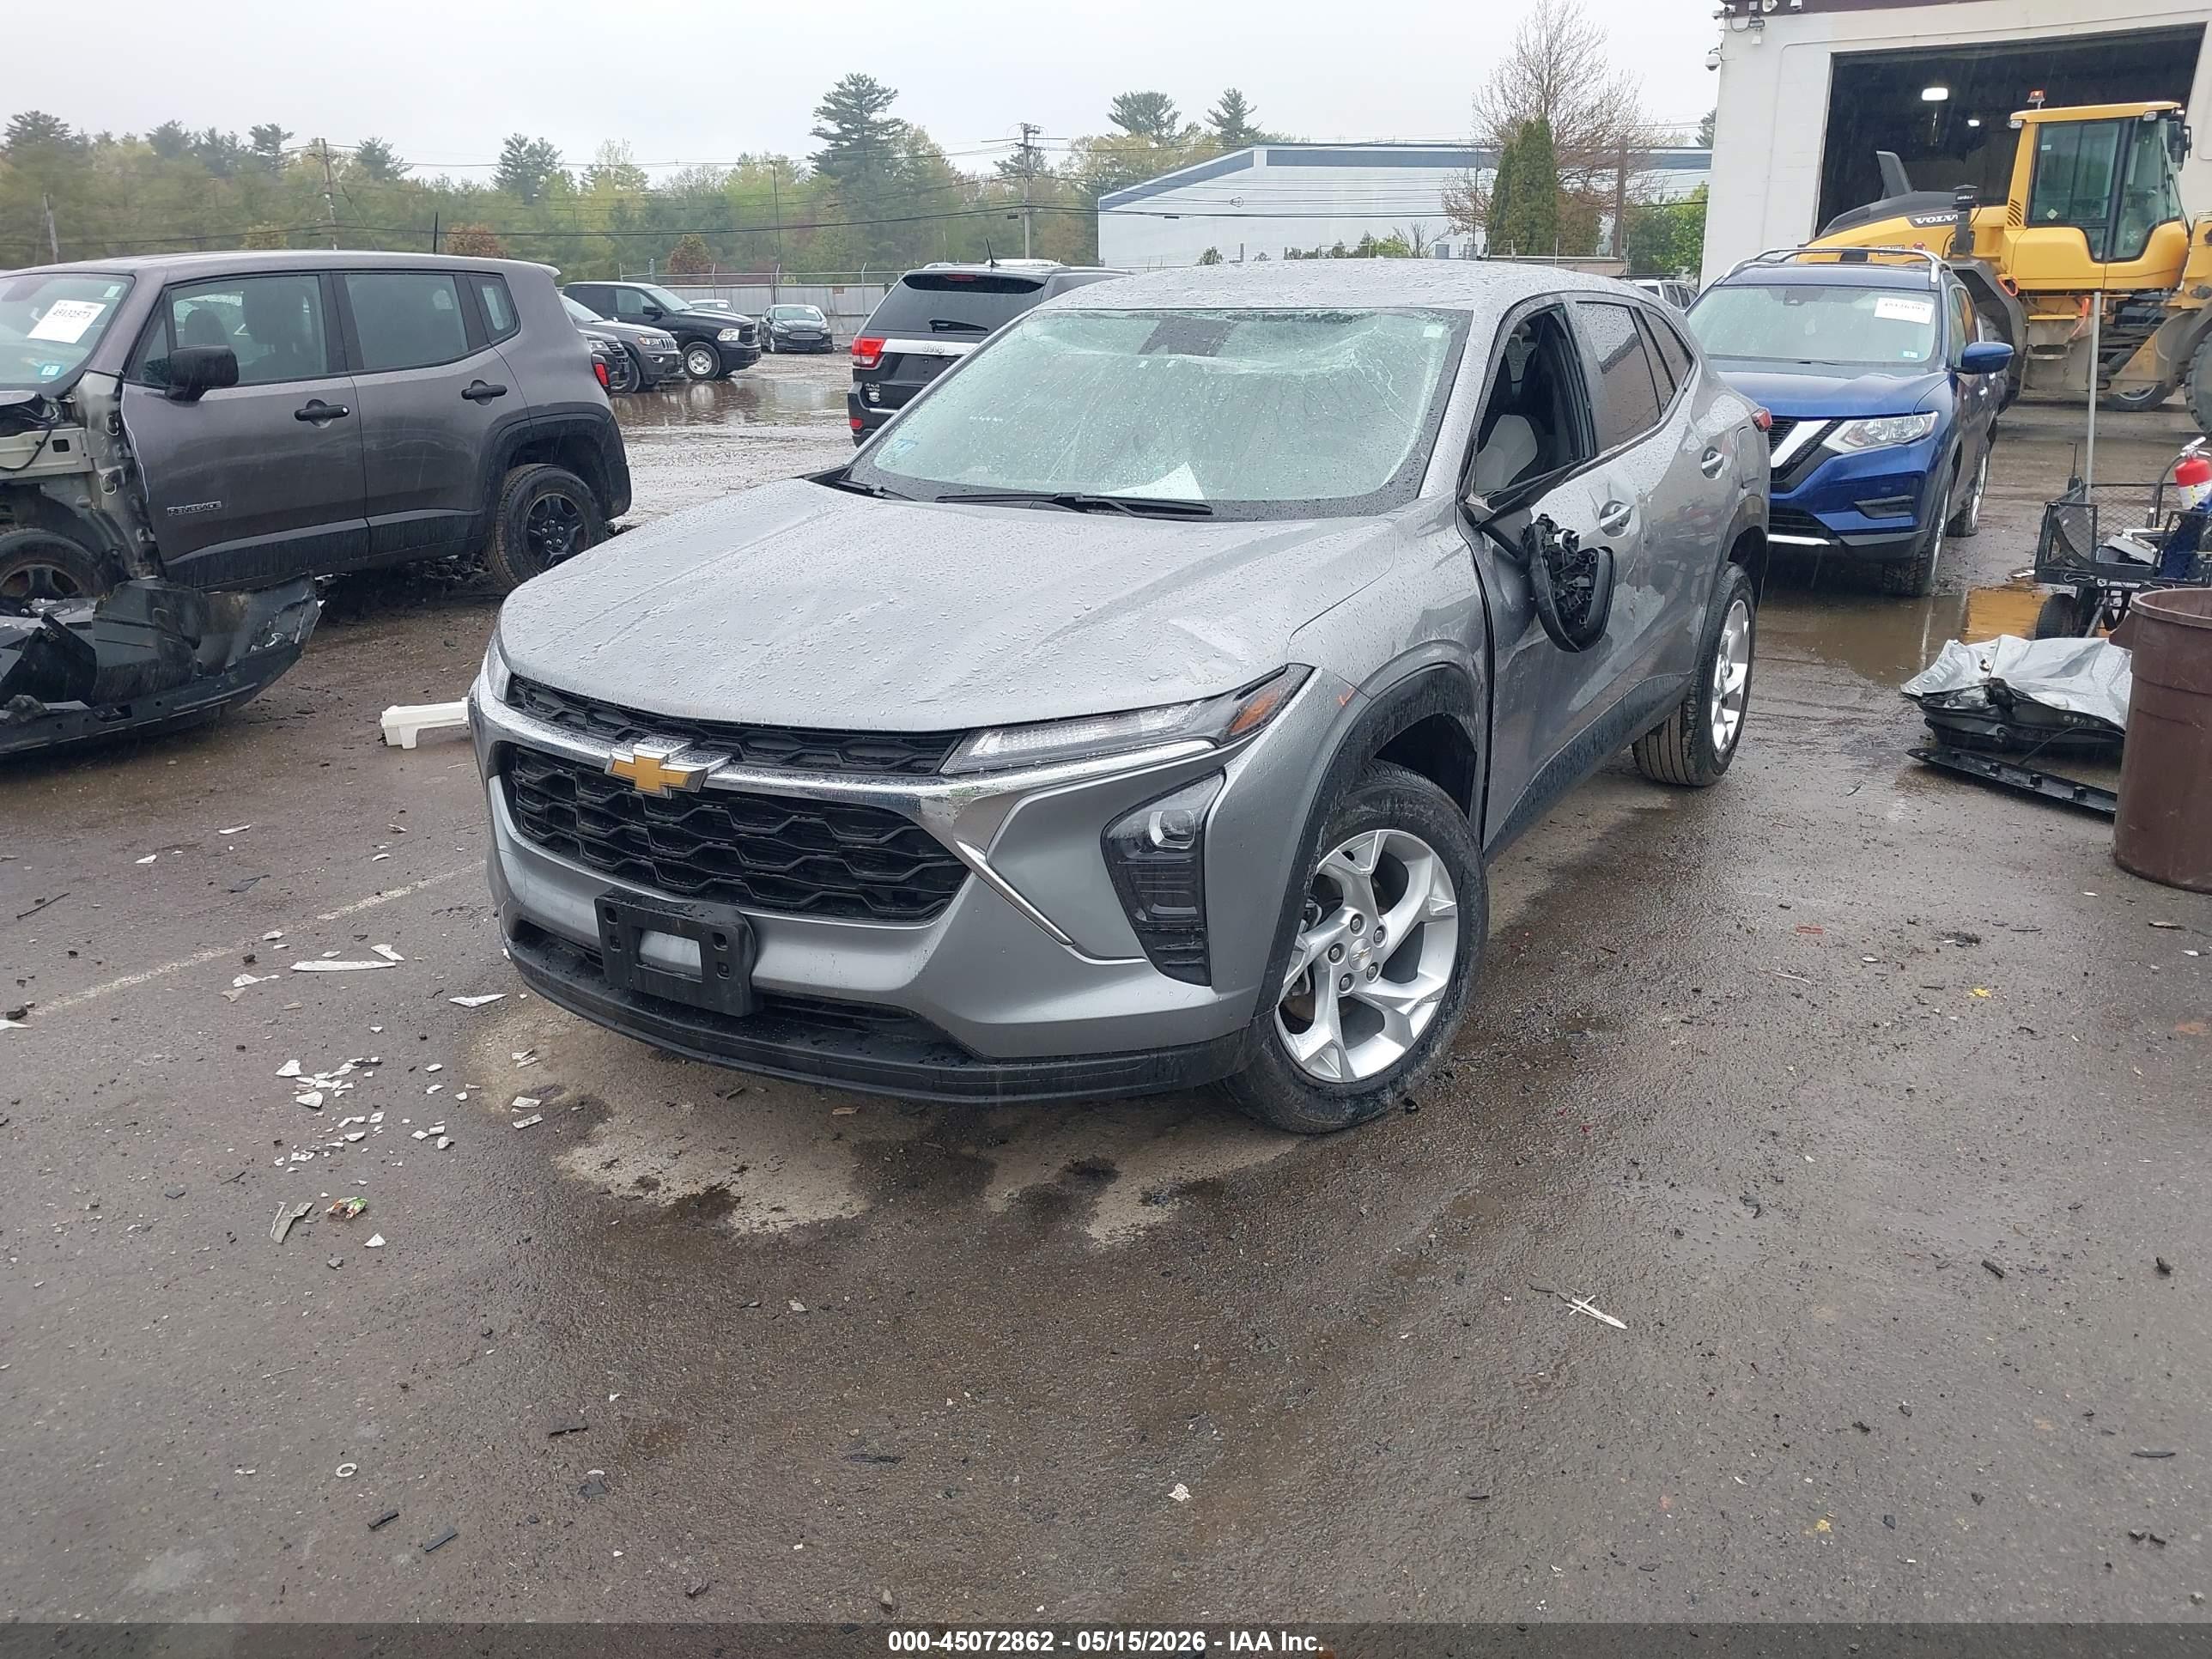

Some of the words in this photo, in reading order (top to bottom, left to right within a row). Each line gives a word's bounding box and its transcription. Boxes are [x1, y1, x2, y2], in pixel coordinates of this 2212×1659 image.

[1914, 215, 1958, 225] VOLV
[922, 343, 945, 355] Jeep
[167, 501, 222, 517] RENEGADE
